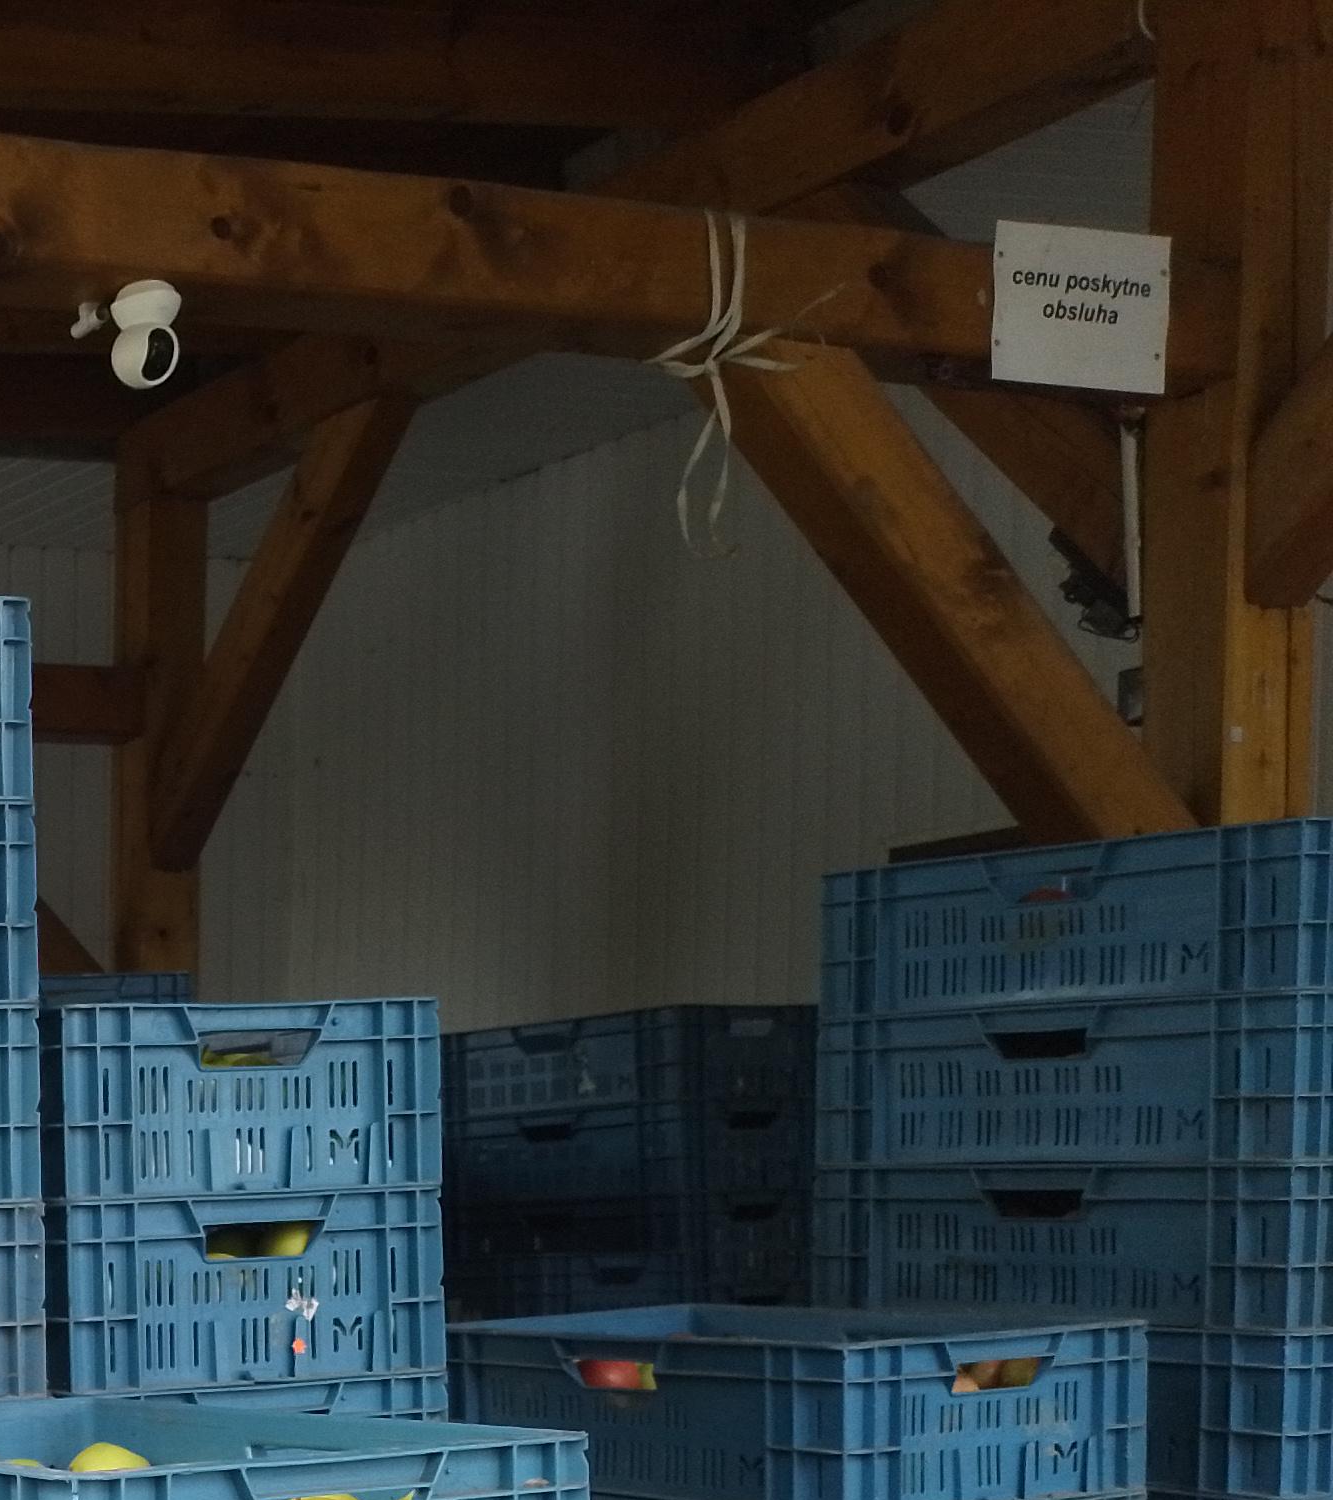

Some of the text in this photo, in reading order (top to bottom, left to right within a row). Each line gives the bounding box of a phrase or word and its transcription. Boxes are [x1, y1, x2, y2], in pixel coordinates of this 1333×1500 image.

[1012, 269, 1151, 299] cenu poskytne
[1042, 300, 1119, 325] obsluha
